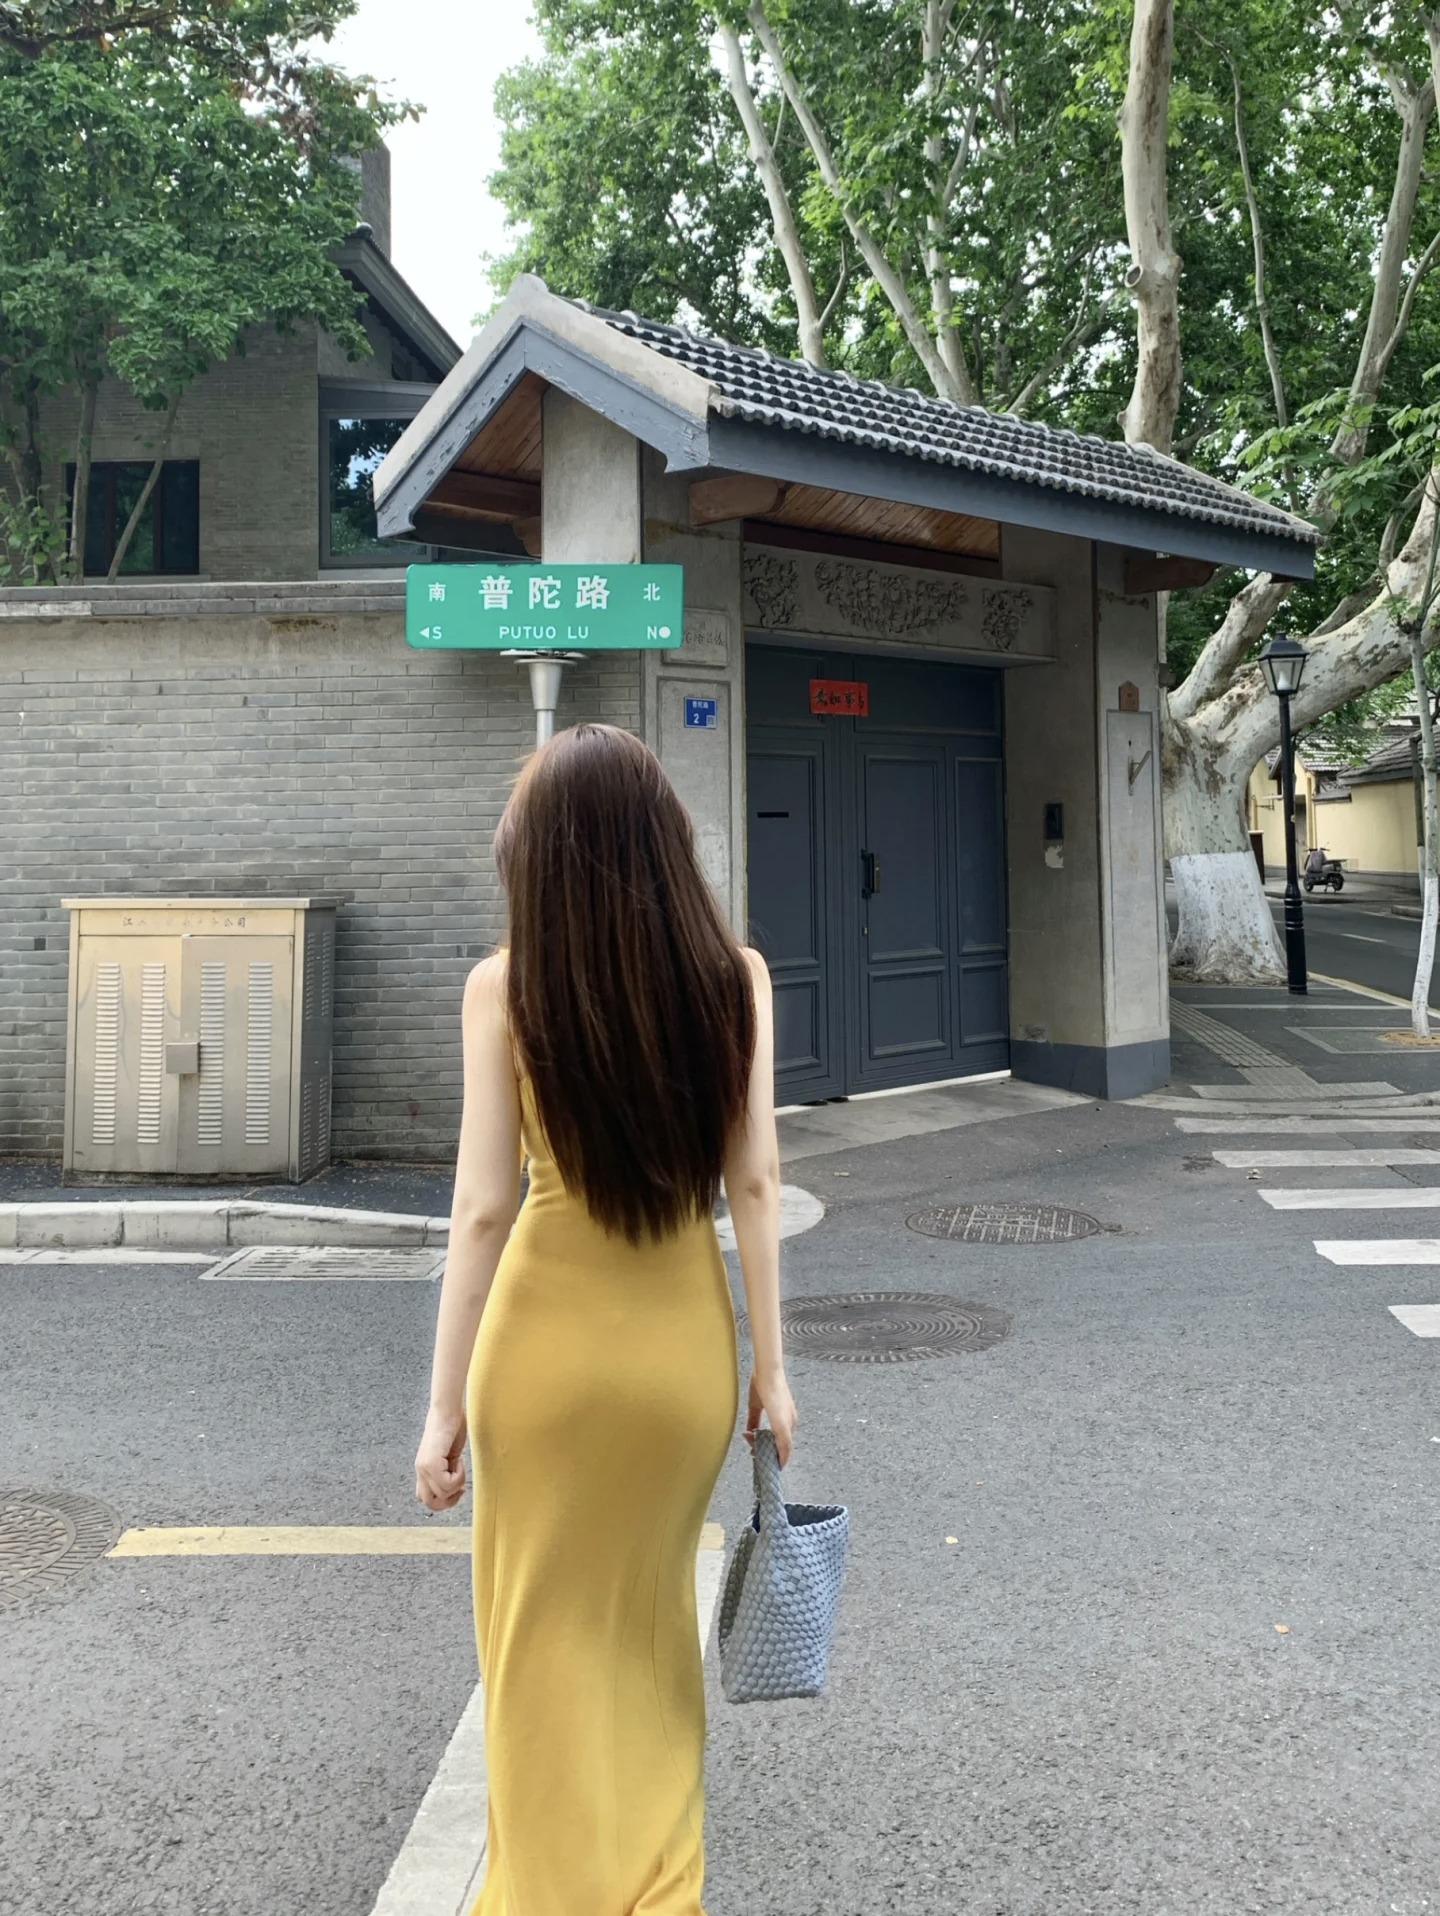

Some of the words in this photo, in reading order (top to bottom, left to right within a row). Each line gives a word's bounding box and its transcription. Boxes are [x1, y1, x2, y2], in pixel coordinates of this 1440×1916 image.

[428, 582, 446, 602] 南
[479, 575, 610, 610] 普陀路
[643, 583, 660, 602] 北
[432, 626, 442, 639] S
[499, 626, 557, 639] PUTUO
[567, 626, 589, 639] LU
[647, 626, 657, 639] N
[693, 712, 700, 724] 2
